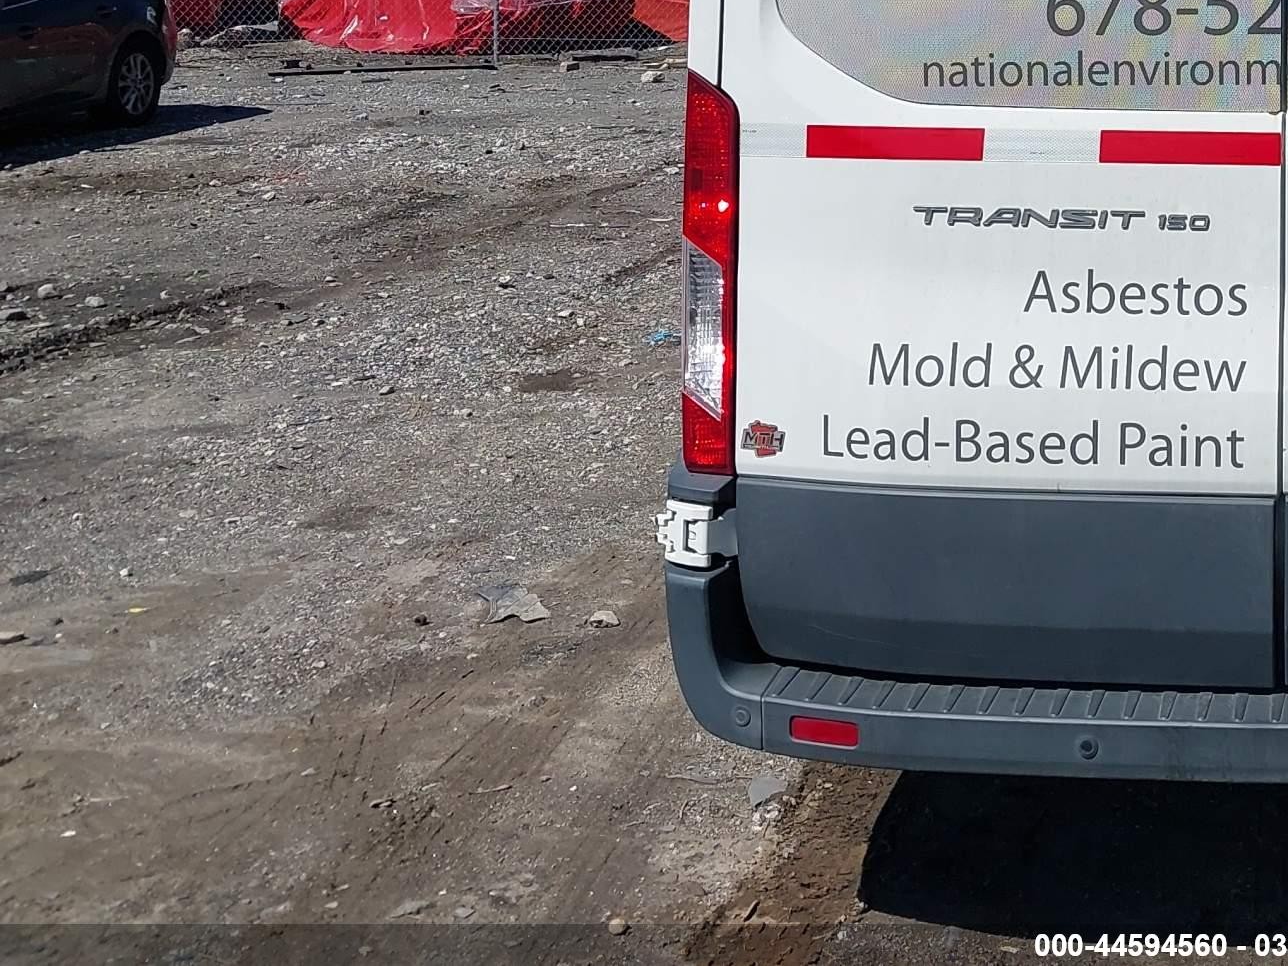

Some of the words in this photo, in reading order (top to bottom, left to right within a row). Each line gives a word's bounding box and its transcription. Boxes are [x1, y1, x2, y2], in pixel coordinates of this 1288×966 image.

[913, 206, 1147, 232] TRANSIT
[1158, 214, 1212, 232] 150
[1023, 269, 1249, 317] Asbestos
[868, 342, 994, 389] Mold
[1009, 345, 1045, 390] &
[1060, 344, 1249, 393] Mildew
[823, 414, 1101, 467] Lead-Based
[1119, 422, 1246, 470] Paint
